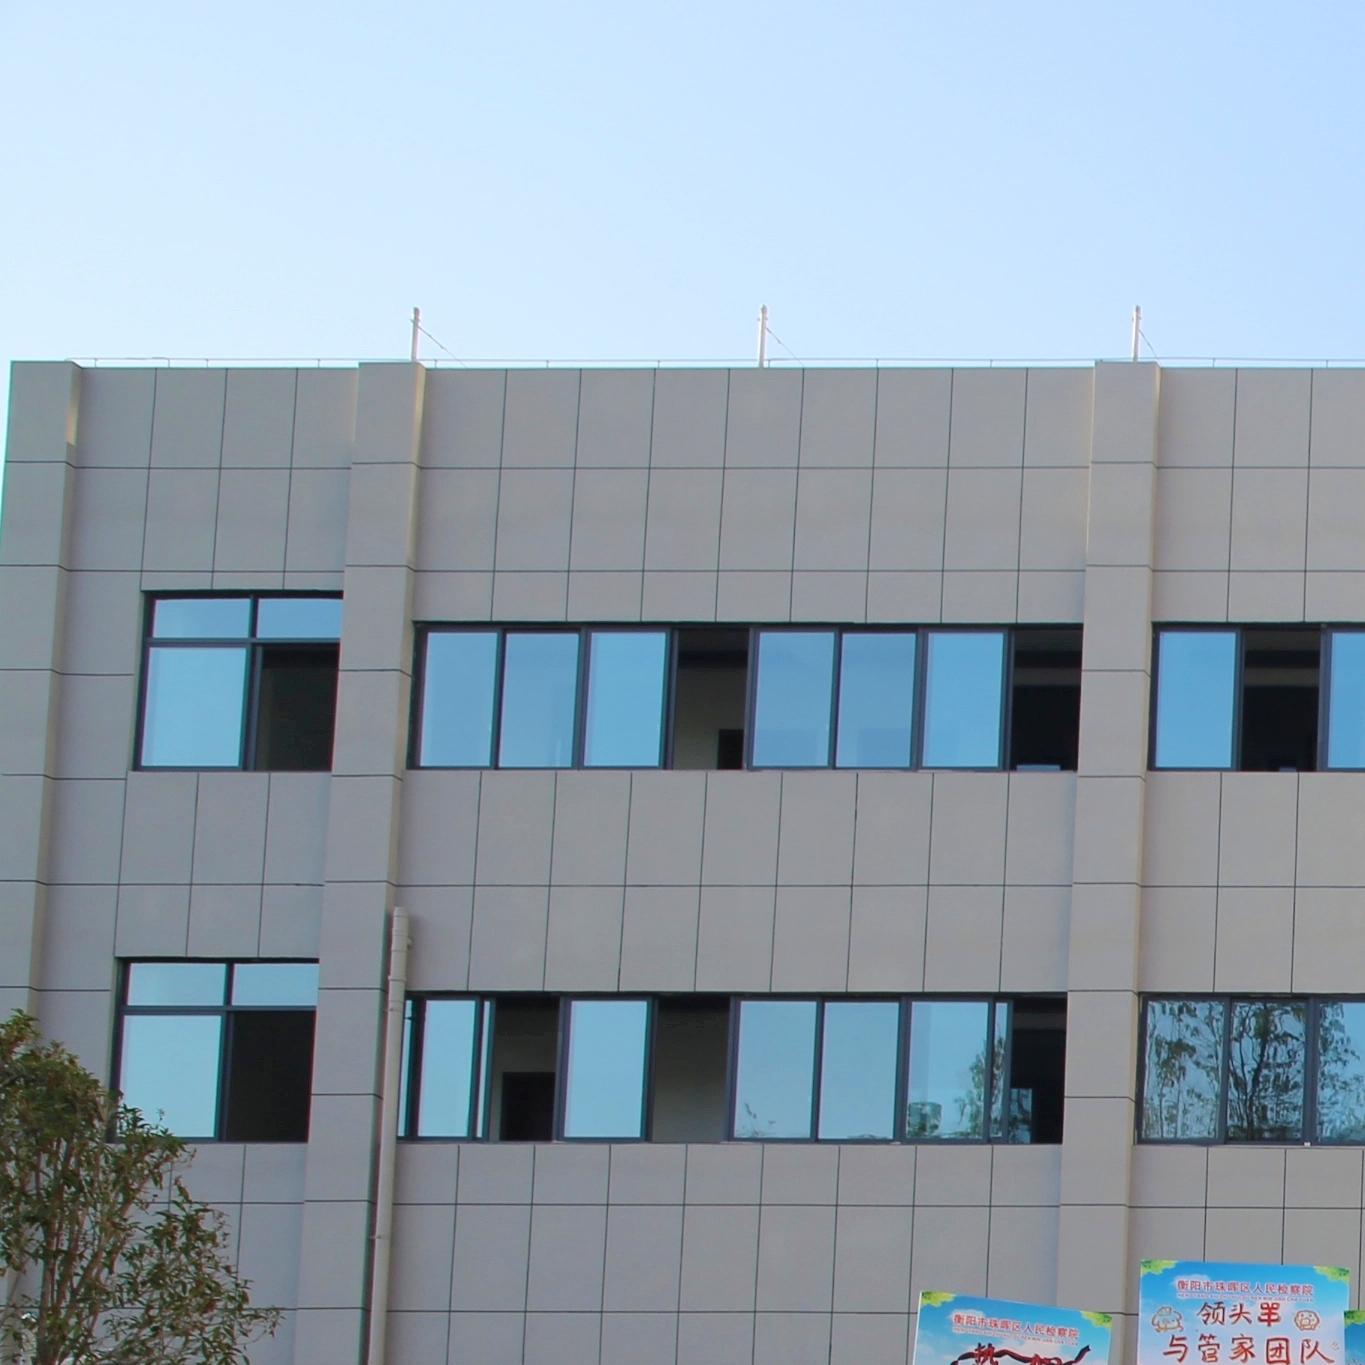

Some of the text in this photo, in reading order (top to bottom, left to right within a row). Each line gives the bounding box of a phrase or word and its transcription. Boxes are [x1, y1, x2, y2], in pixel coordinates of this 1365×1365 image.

[1177, 1279, 1314, 1297] 衡阳市珠晖区人民检察院
[953, 1313, 1079, 1341] 衡阳市珠晖区人民检察院
[1196, 1301, 1282, 1327] 领头羊
[1163, 1333, 1336, 1365] 与管家团队
